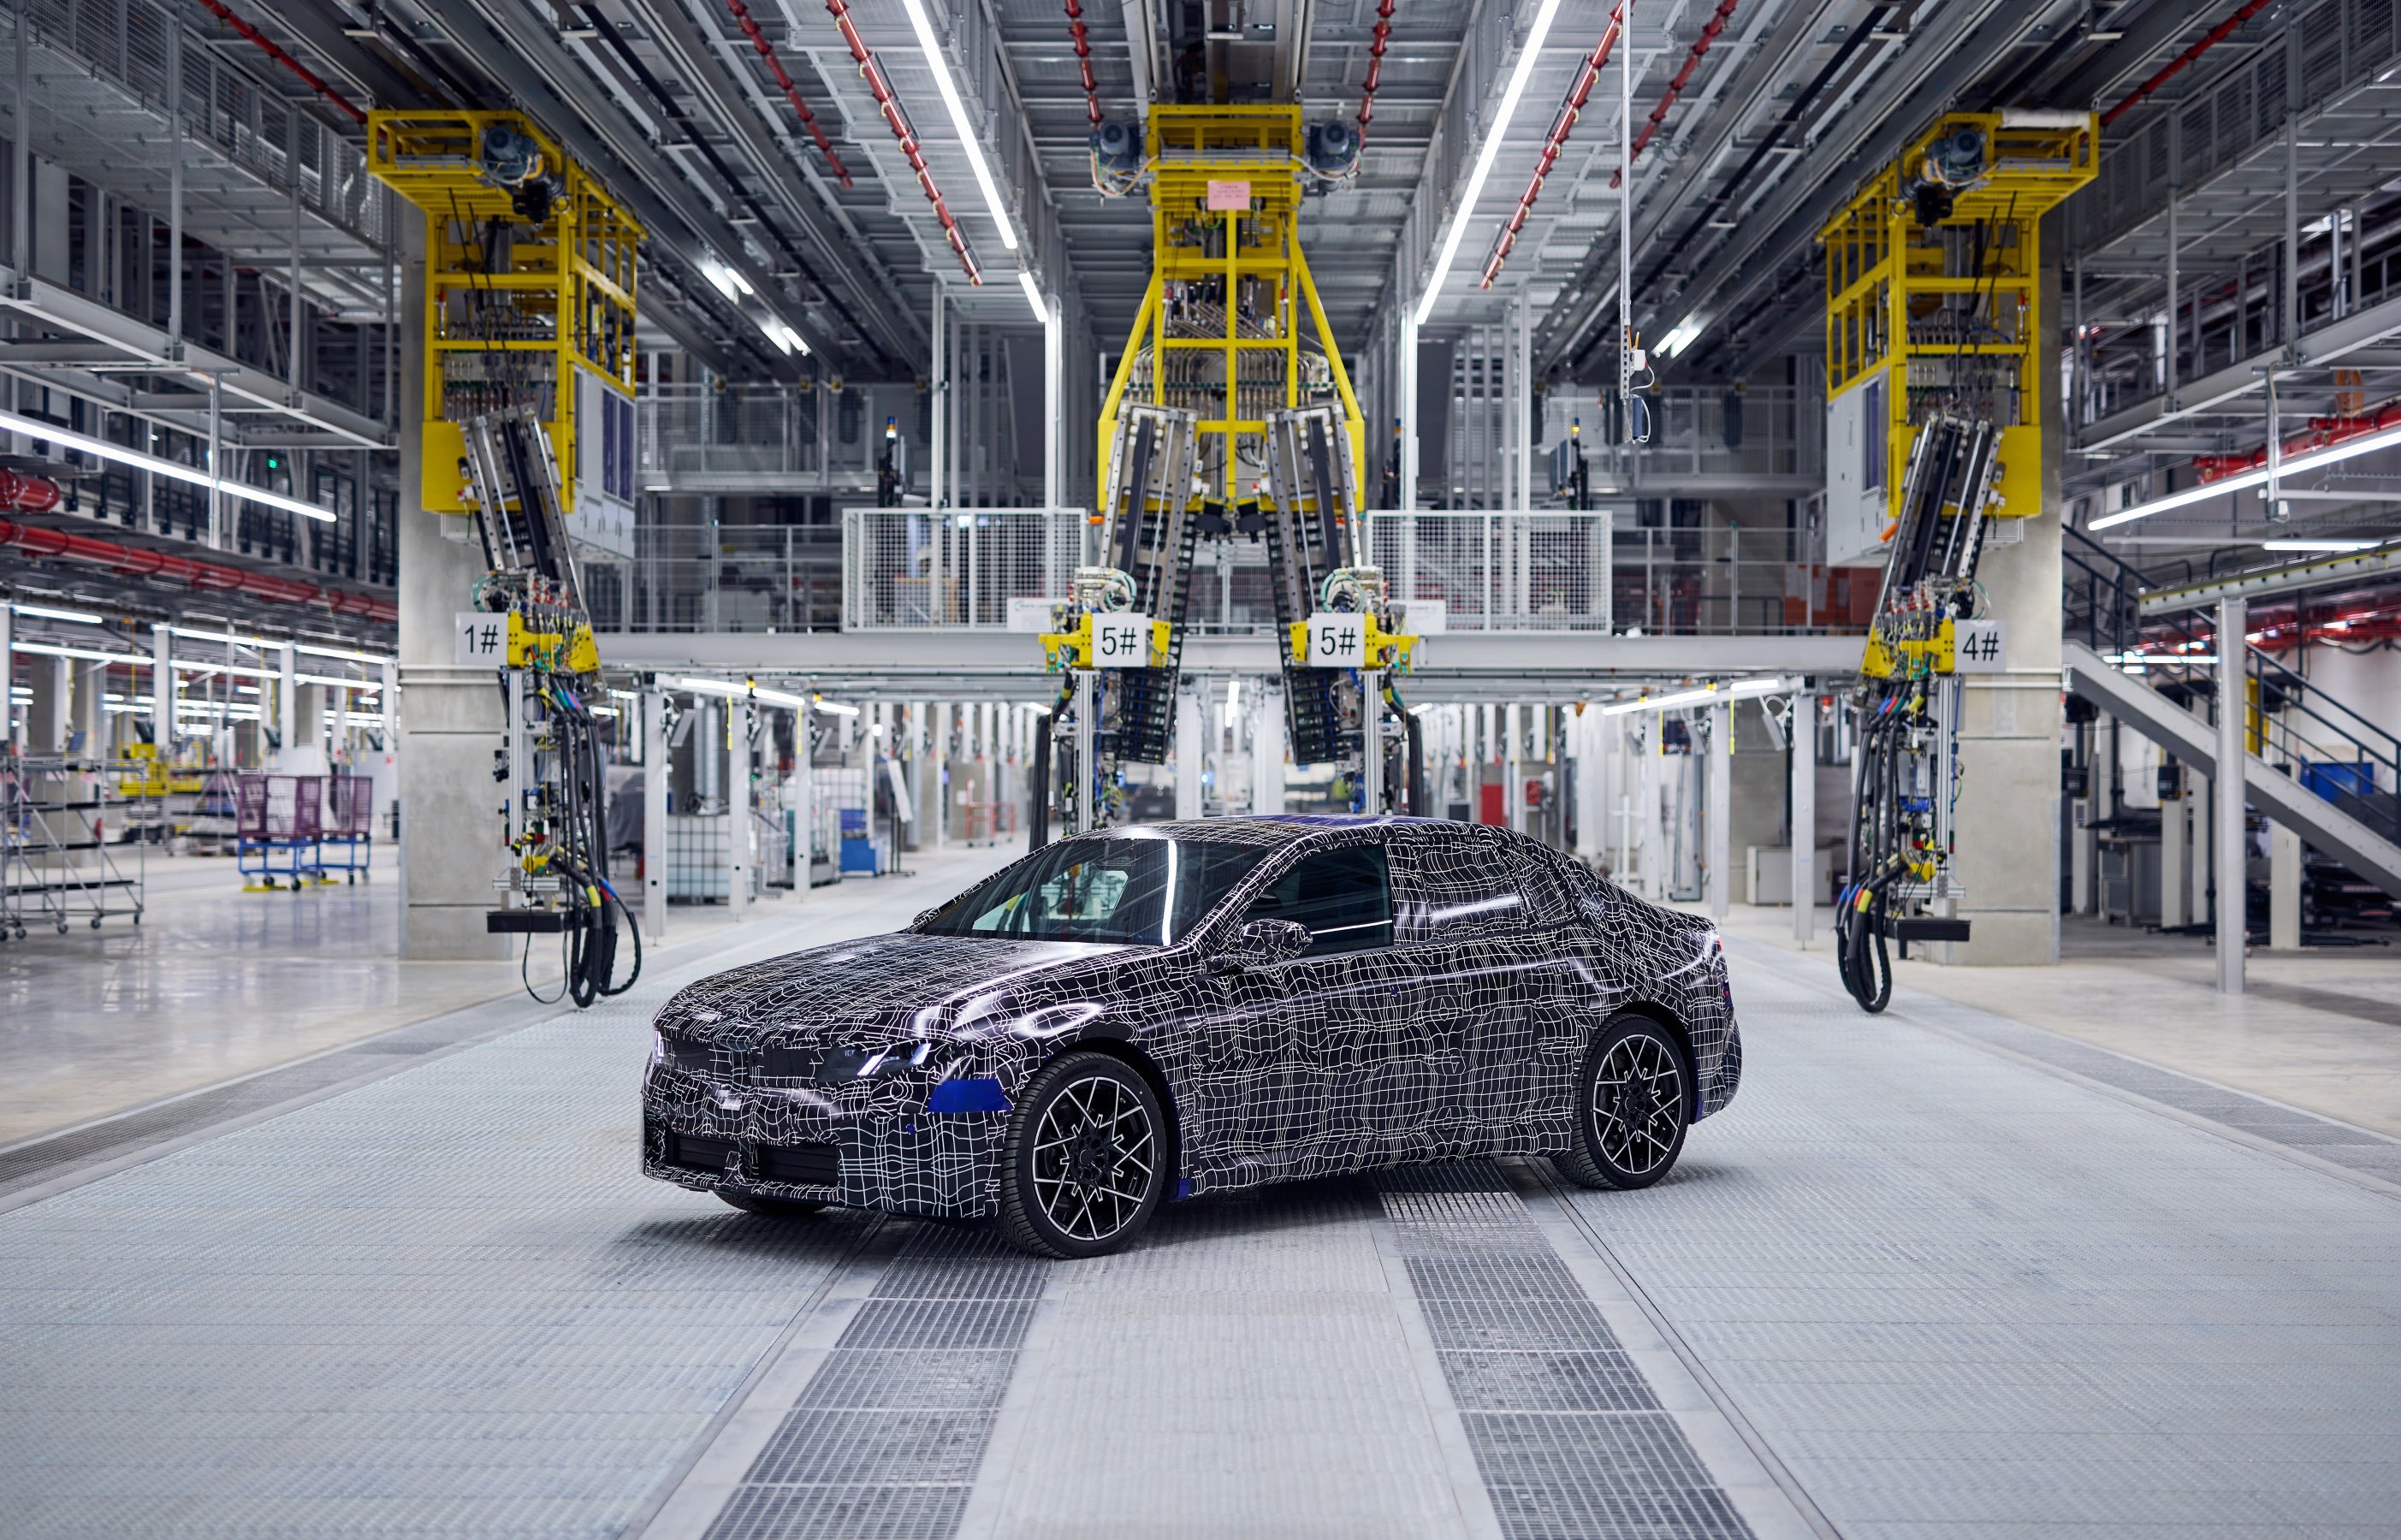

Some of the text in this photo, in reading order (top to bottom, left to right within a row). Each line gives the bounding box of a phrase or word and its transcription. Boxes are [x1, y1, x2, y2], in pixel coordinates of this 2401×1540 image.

[464, 624, 498, 654] 1#
[1101, 627, 1137, 657] 5#
[1320, 626, 1356, 657] 5#
[1963, 631, 2000, 661] 4#
